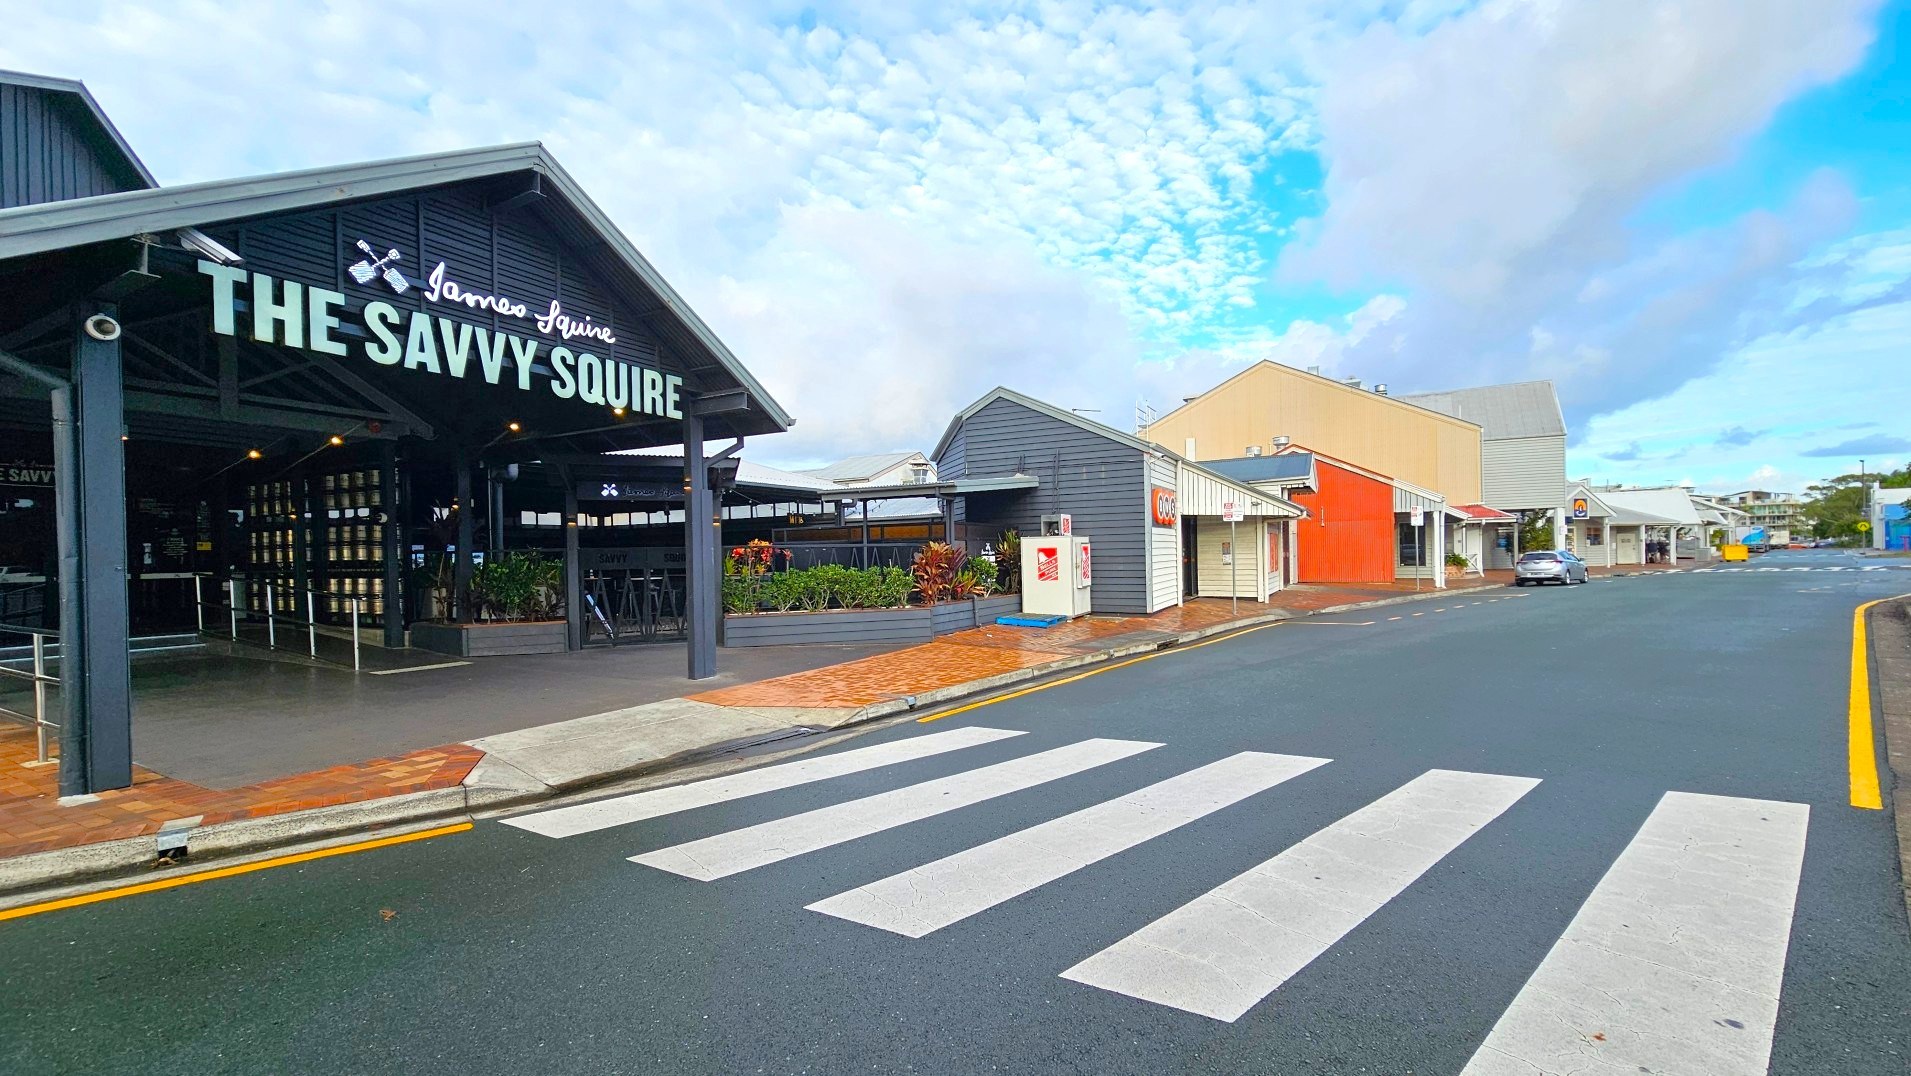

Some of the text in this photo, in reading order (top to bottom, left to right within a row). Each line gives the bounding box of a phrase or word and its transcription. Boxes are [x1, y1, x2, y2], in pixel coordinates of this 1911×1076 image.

[423, 261, 616, 344] James Squire
[197, 259, 683, 420] THE SAVVY SQUIRE
[9, 468, 55, 482] SAVV
[599, 553, 628, 565] SAVVY
